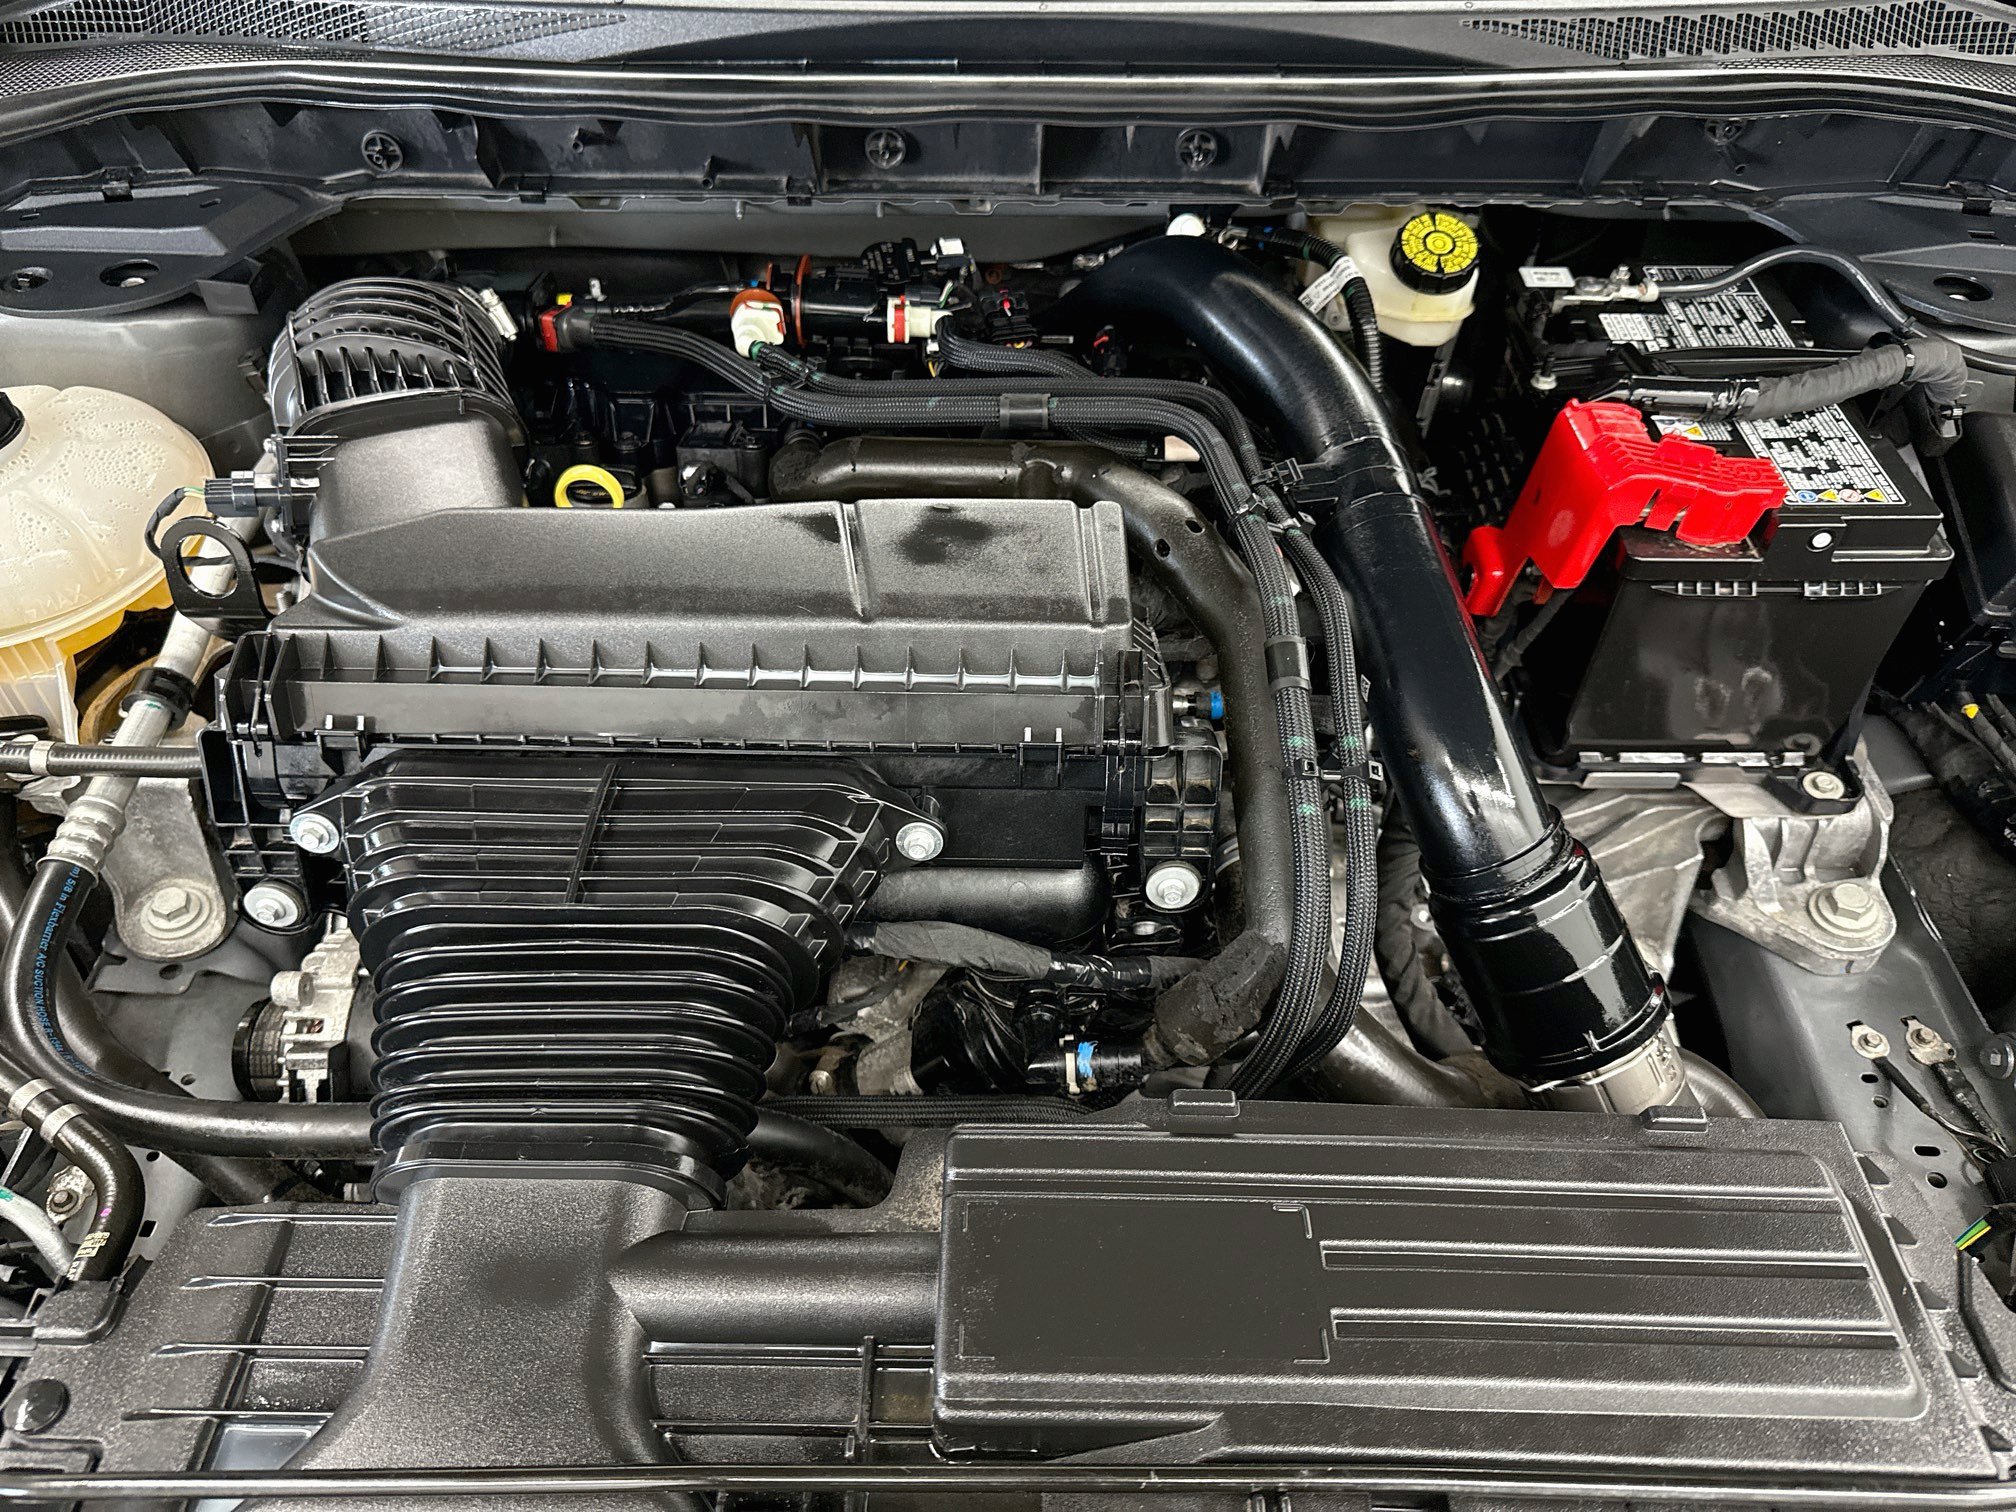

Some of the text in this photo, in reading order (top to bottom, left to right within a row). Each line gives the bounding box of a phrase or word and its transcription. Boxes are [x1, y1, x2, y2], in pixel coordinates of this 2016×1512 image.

[63, 878, 76, 893] 5/8
[40, 902, 66, 951] Flexbarrier
[36, 953, 47, 968] A/C
[34, 969, 44, 1004] SUCTION
[36, 1005, 51, 1027] HOSE
